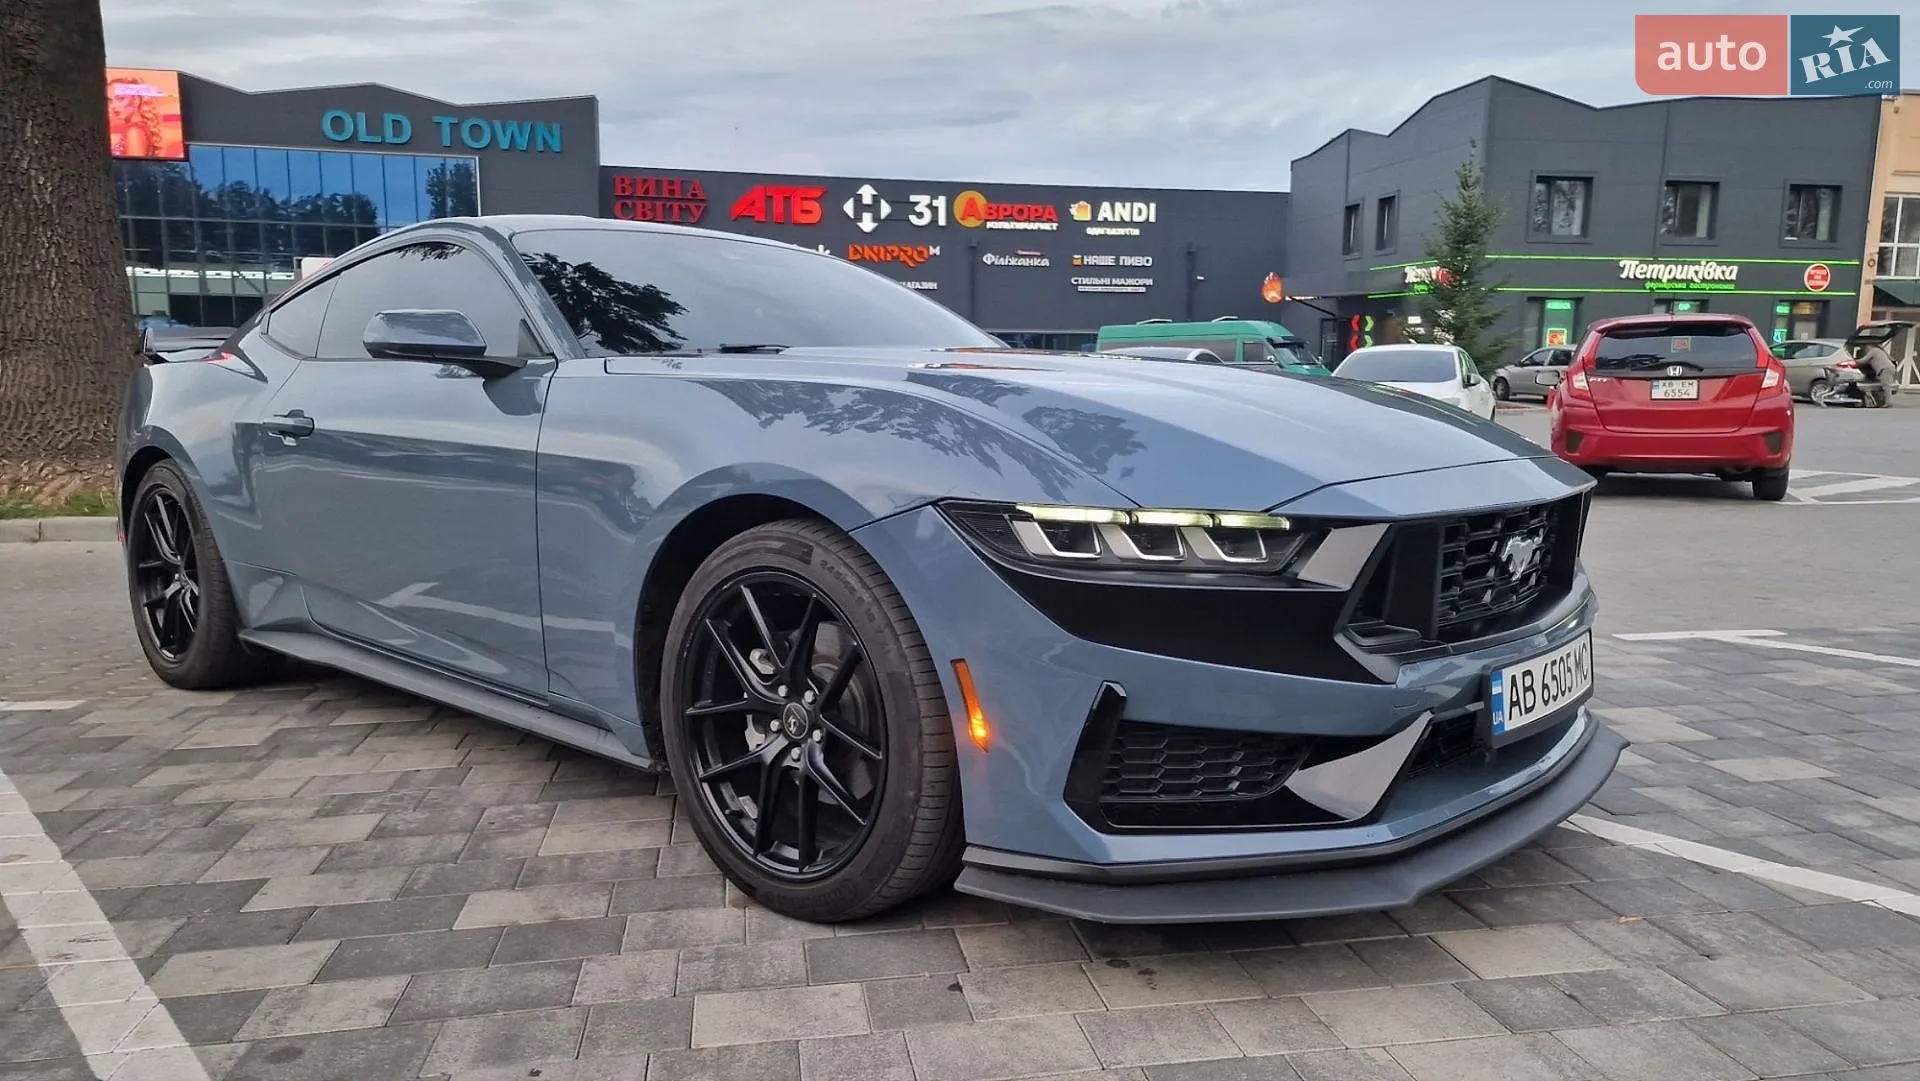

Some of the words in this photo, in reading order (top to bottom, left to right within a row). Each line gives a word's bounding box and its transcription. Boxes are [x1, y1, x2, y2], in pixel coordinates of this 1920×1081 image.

[321, 109, 412, 144] OLD
[432, 115, 562, 153] TOWN
[613, 176, 706, 200] ВИНА
[613, 200, 707, 224] СВІТУ
[730, 185, 828, 225] АТБ
[1097, 201, 1157, 222] ANDI
[847, 244, 929, 268] DNIPRO
[982, 252, 1050, 267] Філіжанка
[1083, 255, 1116, 267] НАШЕ
[1119, 256, 1153, 267] ПИВО
[1071, 276, 1111, 285] СТИЛЬНІ
[1112, 278, 1153, 287] МАЖОРИ
[1618, 260, 1739, 283] Петриківка
[1663, 388, 1691, 398] 6554
[1508, 668, 1537, 721] AB
[1541, 651, 1573, 708] 6505
